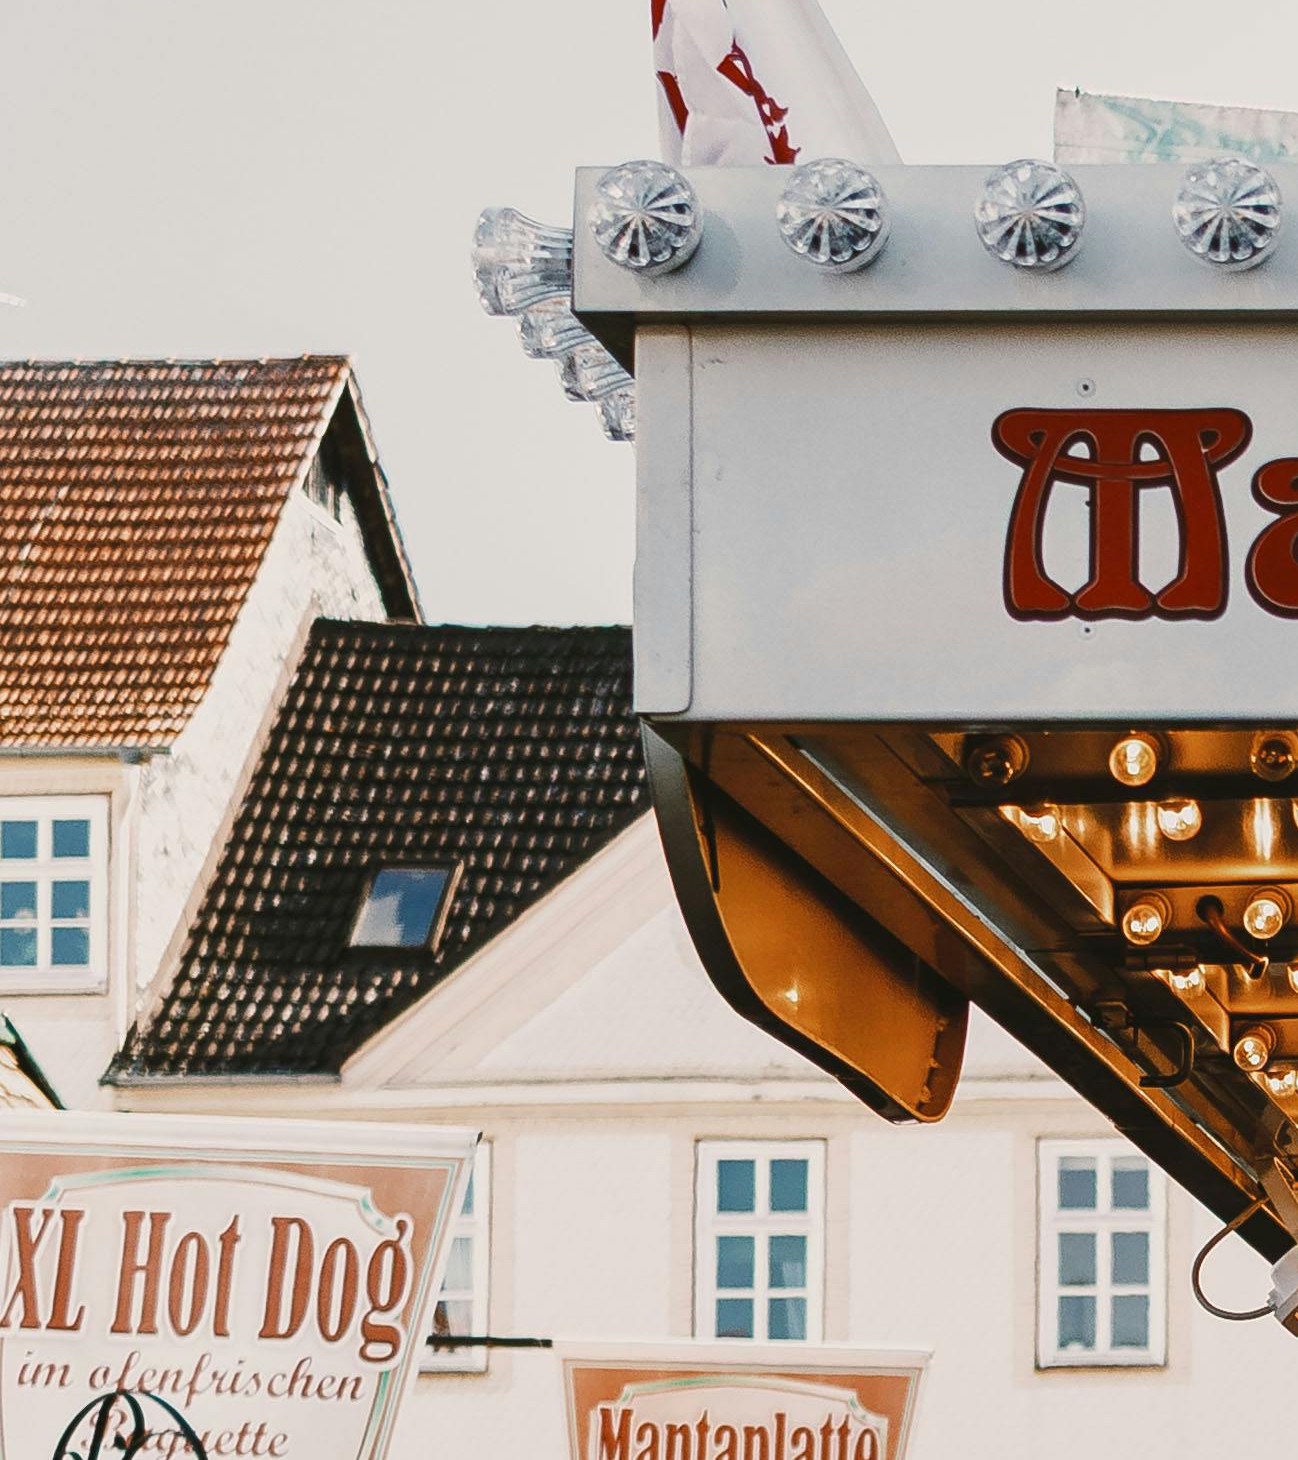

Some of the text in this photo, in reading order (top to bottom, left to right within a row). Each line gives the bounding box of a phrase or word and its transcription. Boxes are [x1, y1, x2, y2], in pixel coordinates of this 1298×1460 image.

[110, 1210, 242, 1338] Hot
[258, 1217, 410, 1362] Dog
[17, 1350, 364, 1408] im ofenfrischen
